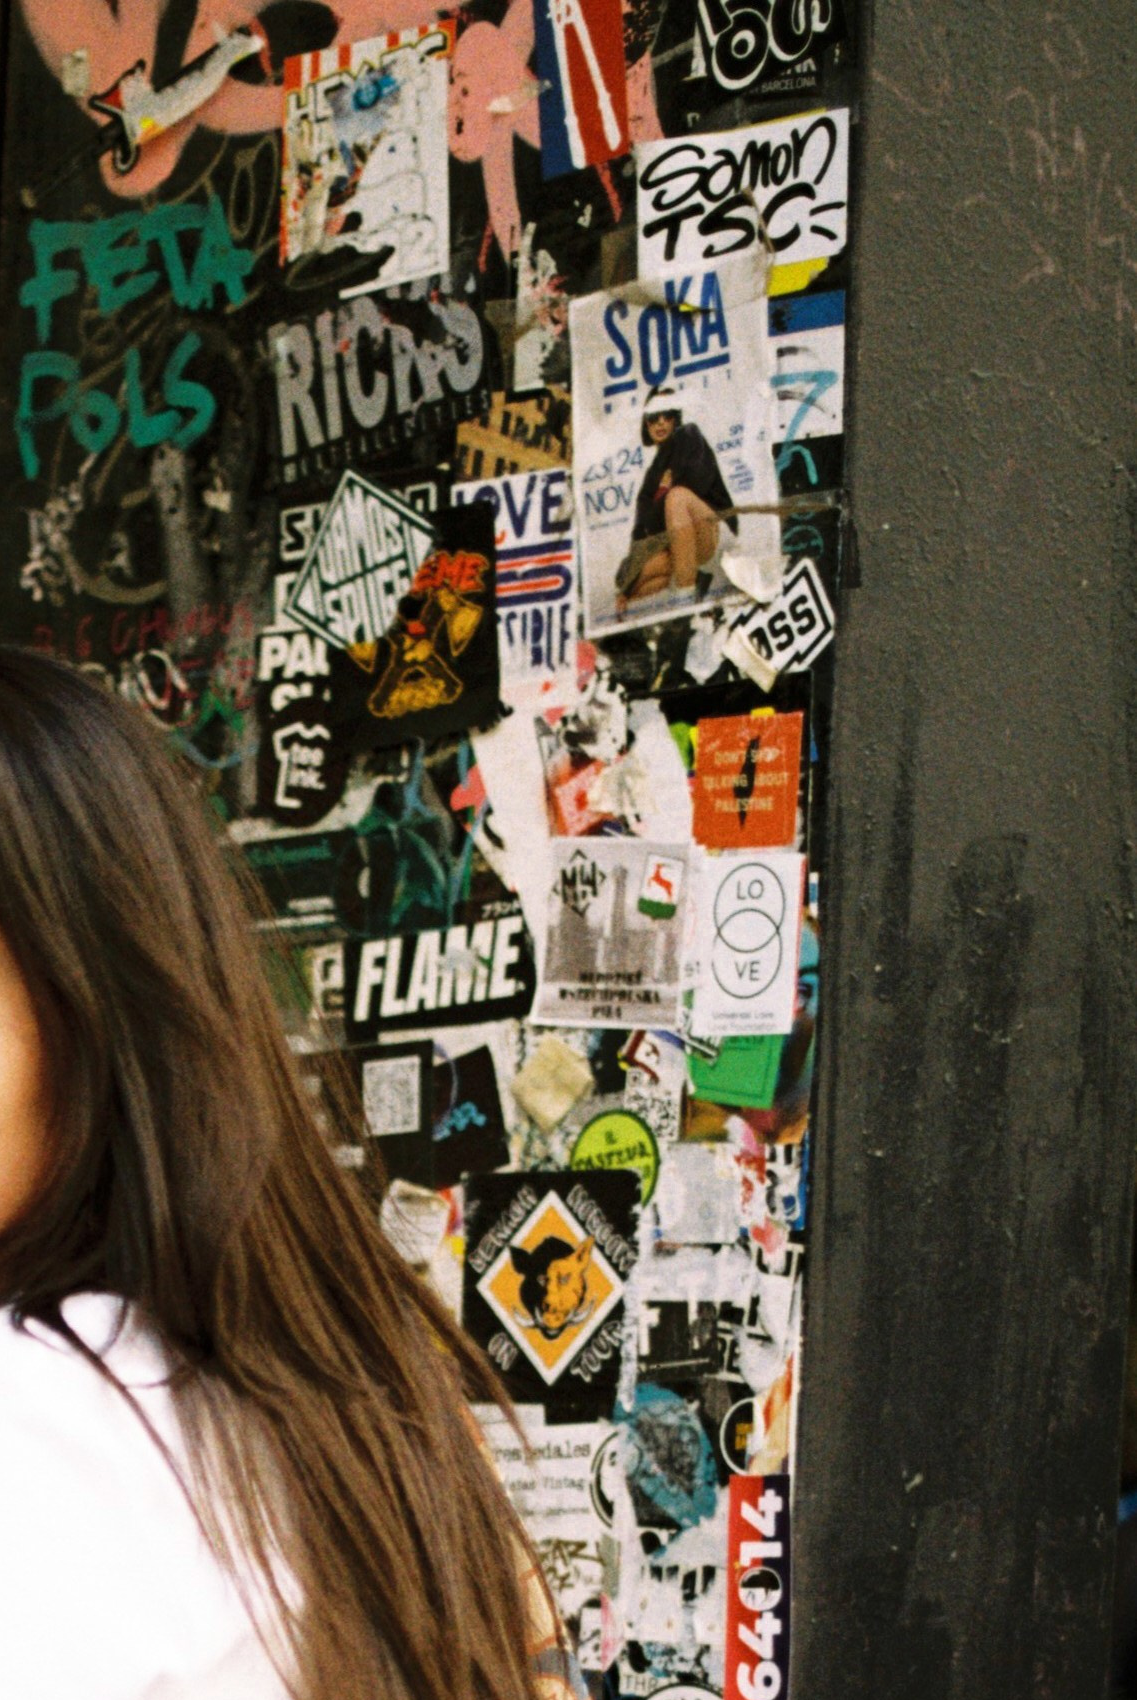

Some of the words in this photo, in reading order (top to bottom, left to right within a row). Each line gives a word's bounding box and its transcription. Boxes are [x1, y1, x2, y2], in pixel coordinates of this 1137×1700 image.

[19, 194, 255, 345] FETA
[603, 270, 730, 388] SOKA
[617, 445, 644, 475] 24
[454, 471, 572, 539] OVE
[584, 481, 636, 516] NOV
[736, 878, 765, 901] LO
[355, 915, 520, 1023] FLAME
[734, 960, 761, 982] VE
